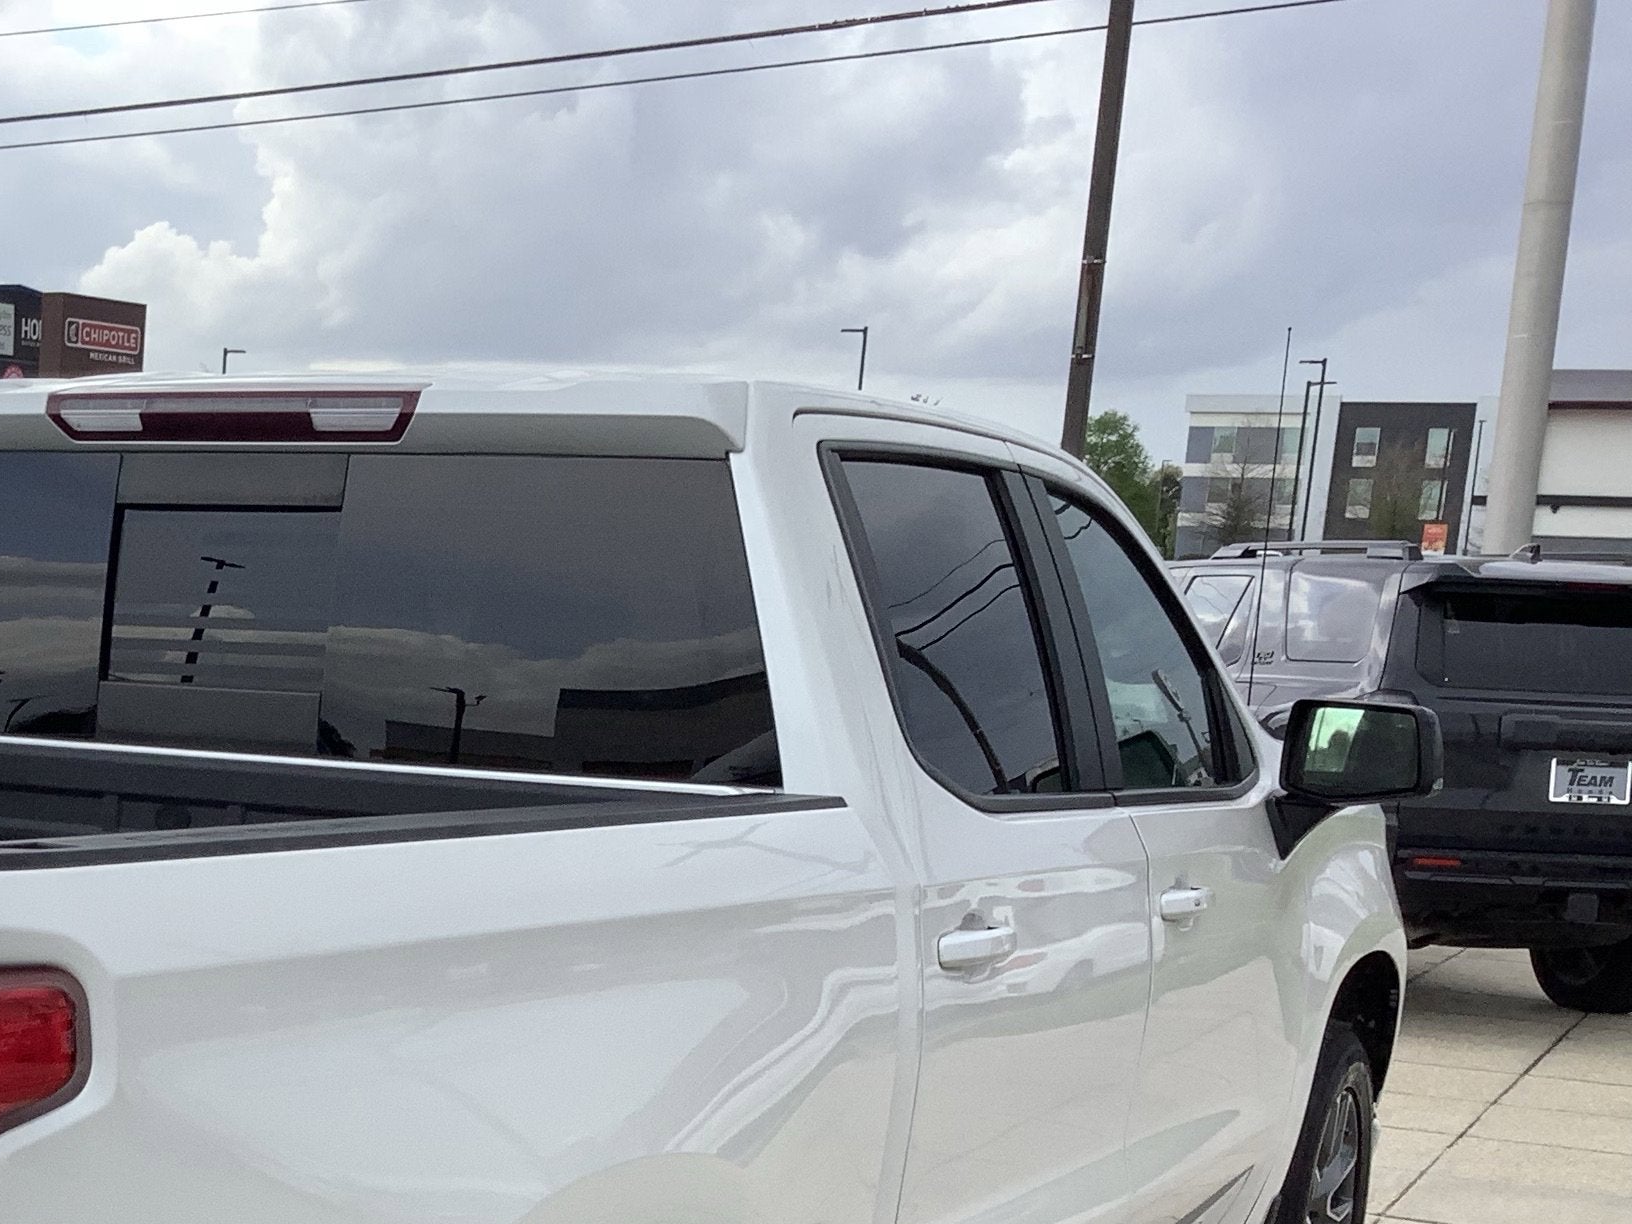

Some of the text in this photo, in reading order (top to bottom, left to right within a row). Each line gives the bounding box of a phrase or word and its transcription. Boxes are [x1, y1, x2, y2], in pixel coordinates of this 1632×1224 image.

[82, 326, 137, 348] CHIPOTLE
[89, 351, 117, 362] MEXICAN
[1567, 767, 1615, 788] TEAM
